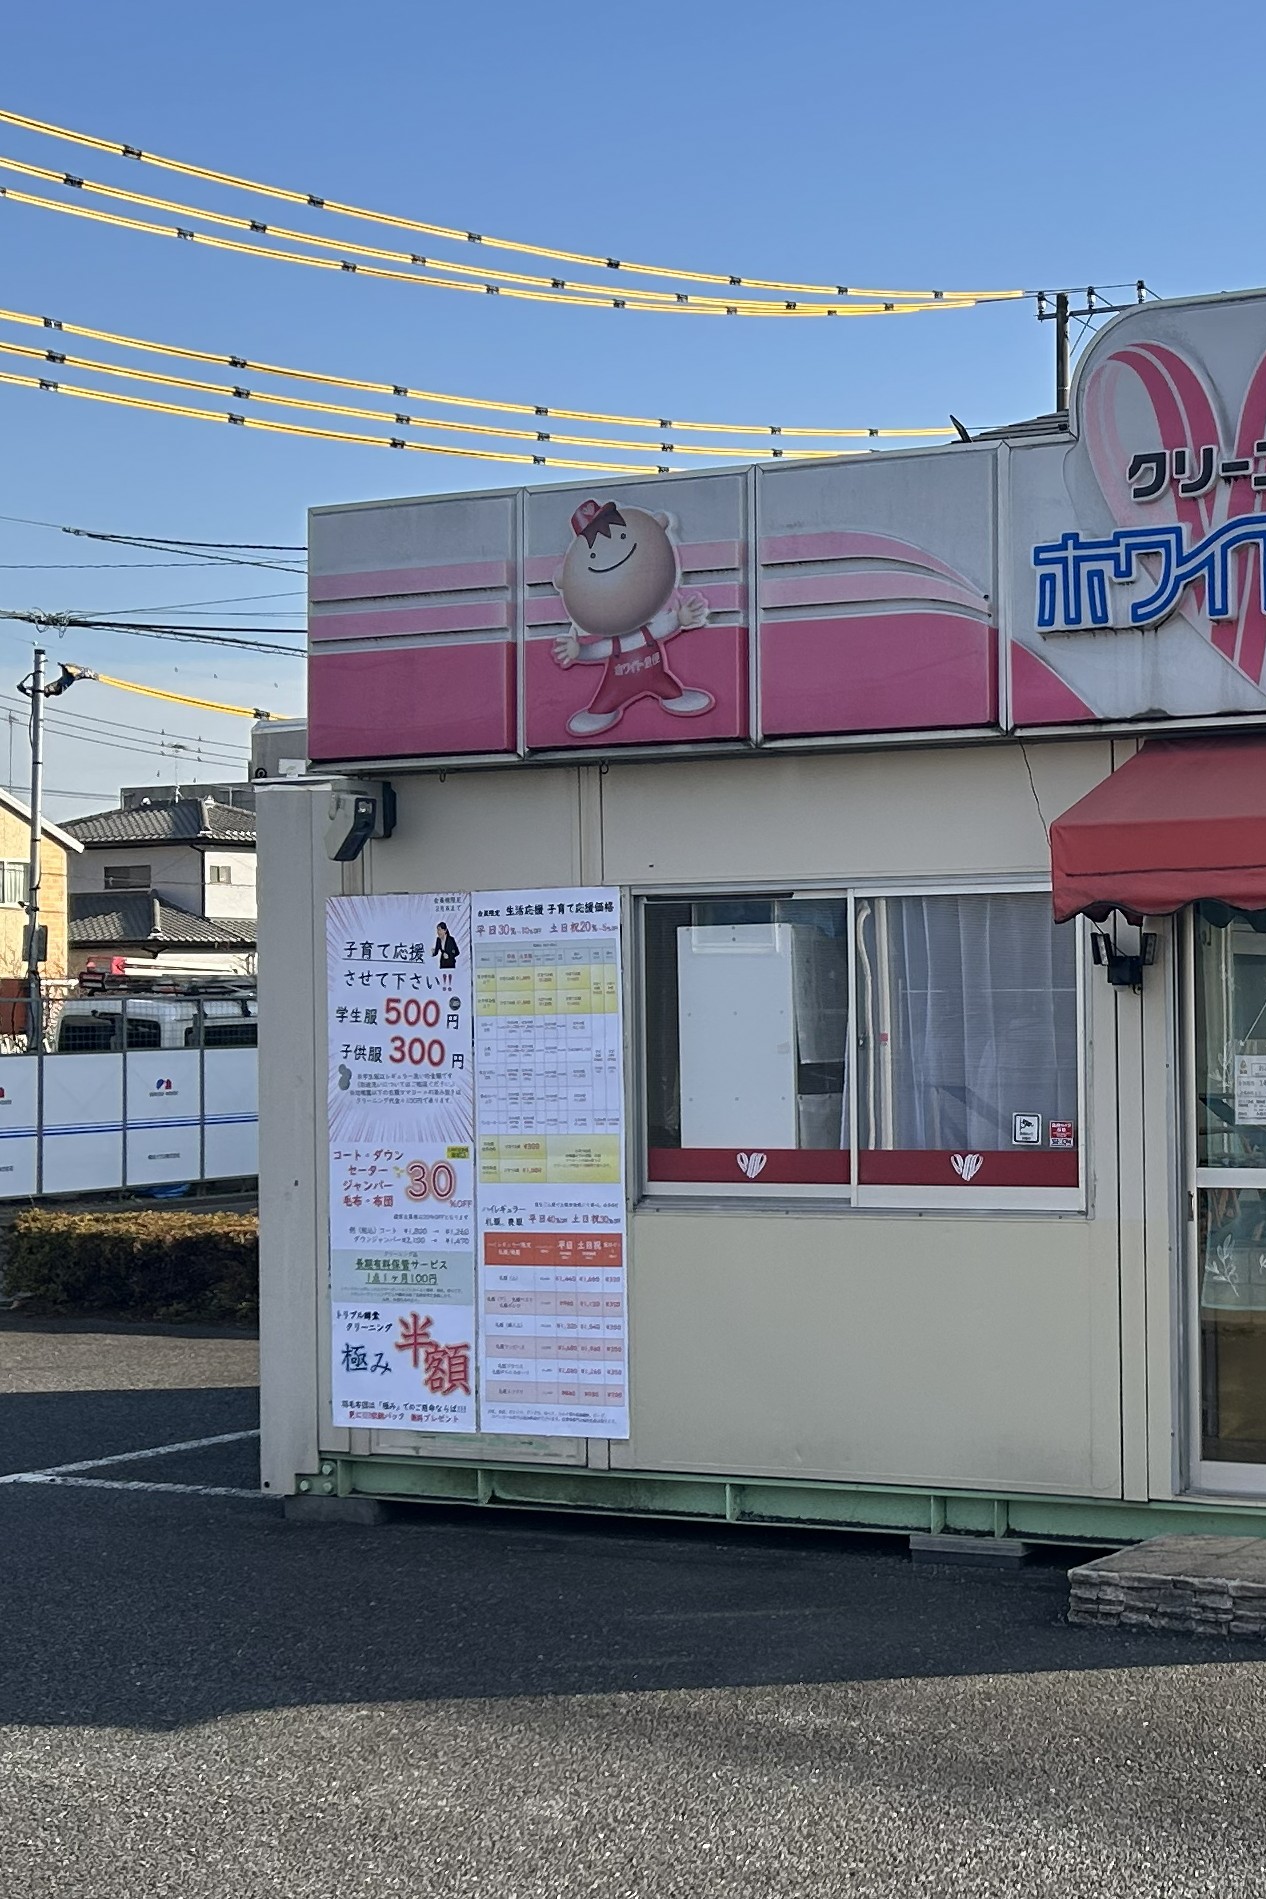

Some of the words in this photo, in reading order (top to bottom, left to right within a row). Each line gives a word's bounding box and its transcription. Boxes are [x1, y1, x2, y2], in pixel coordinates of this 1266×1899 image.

[343, 940, 425, 963] 子育て応援
[335, 1005, 378, 1026] 学生服
[385, 997, 441, 1028] 500
[446, 1013, 460, 1030] 円
[339, 1043, 383, 1063] 子供服
[389, 1035, 446, 1067] 300
[451, 1053, 465, 1070] 円
[333, 1148, 404, 1162] コート・ダウン
[348, 1164, 389, 1177] セーター
[405, 1160, 456, 1201] 30
[340, 1341, 392, 1375] 極み
[394, 1310, 472, 1397] 半額
